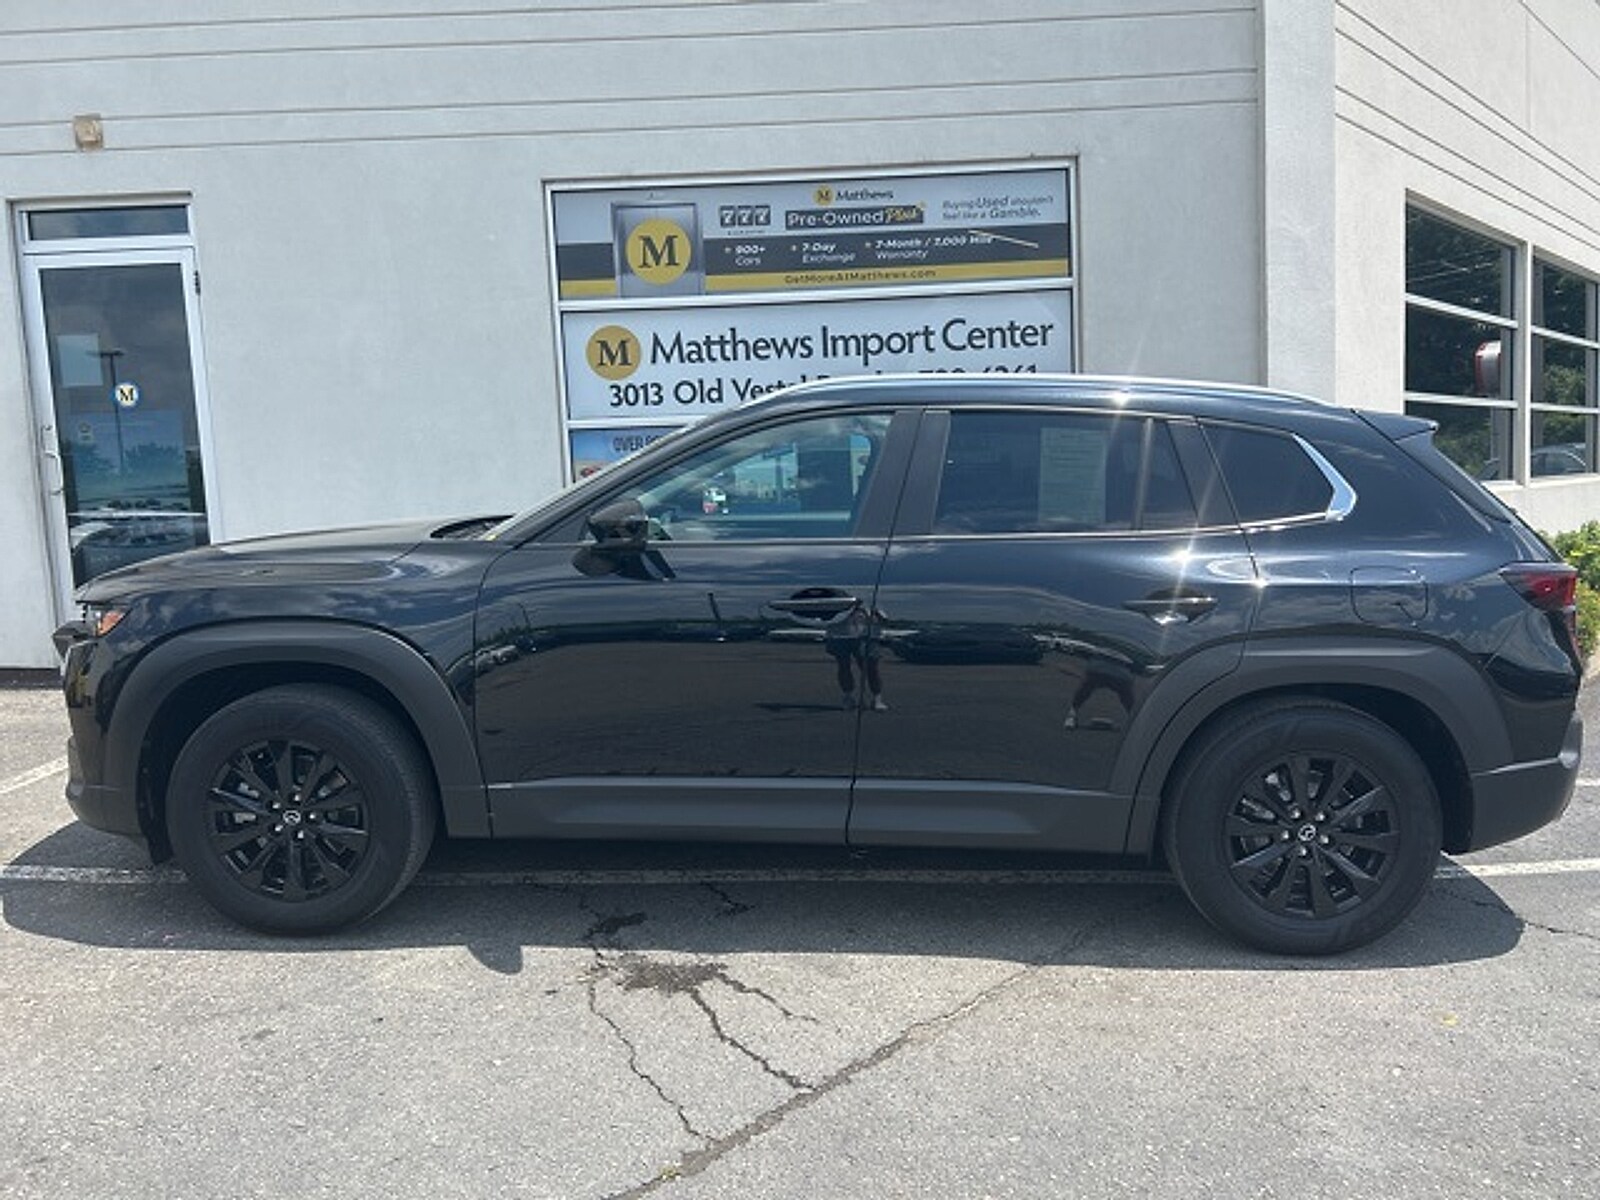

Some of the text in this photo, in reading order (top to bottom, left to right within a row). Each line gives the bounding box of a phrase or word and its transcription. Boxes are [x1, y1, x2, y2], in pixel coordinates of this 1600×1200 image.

[817, 187, 894, 201] M Matthews
[977, 195, 1009, 209] Used
[788, 208, 884, 227] Pre-Owned
[989, 207, 1042, 219] Gamble.
[637, 234, 680, 269] M
[802, 252, 856, 264] Exchange
[875, 249, 929, 260] Warranty
[735, 255, 761, 266] Cars
[784, 270, 937, 285] GetMoreAtMatthews.com
[597, 318, 1054, 367] M Matthews Import Center
[119, 387, 134, 401] M
[609, 381, 664, 407] 3013
[673, 378, 724, 404] Old
